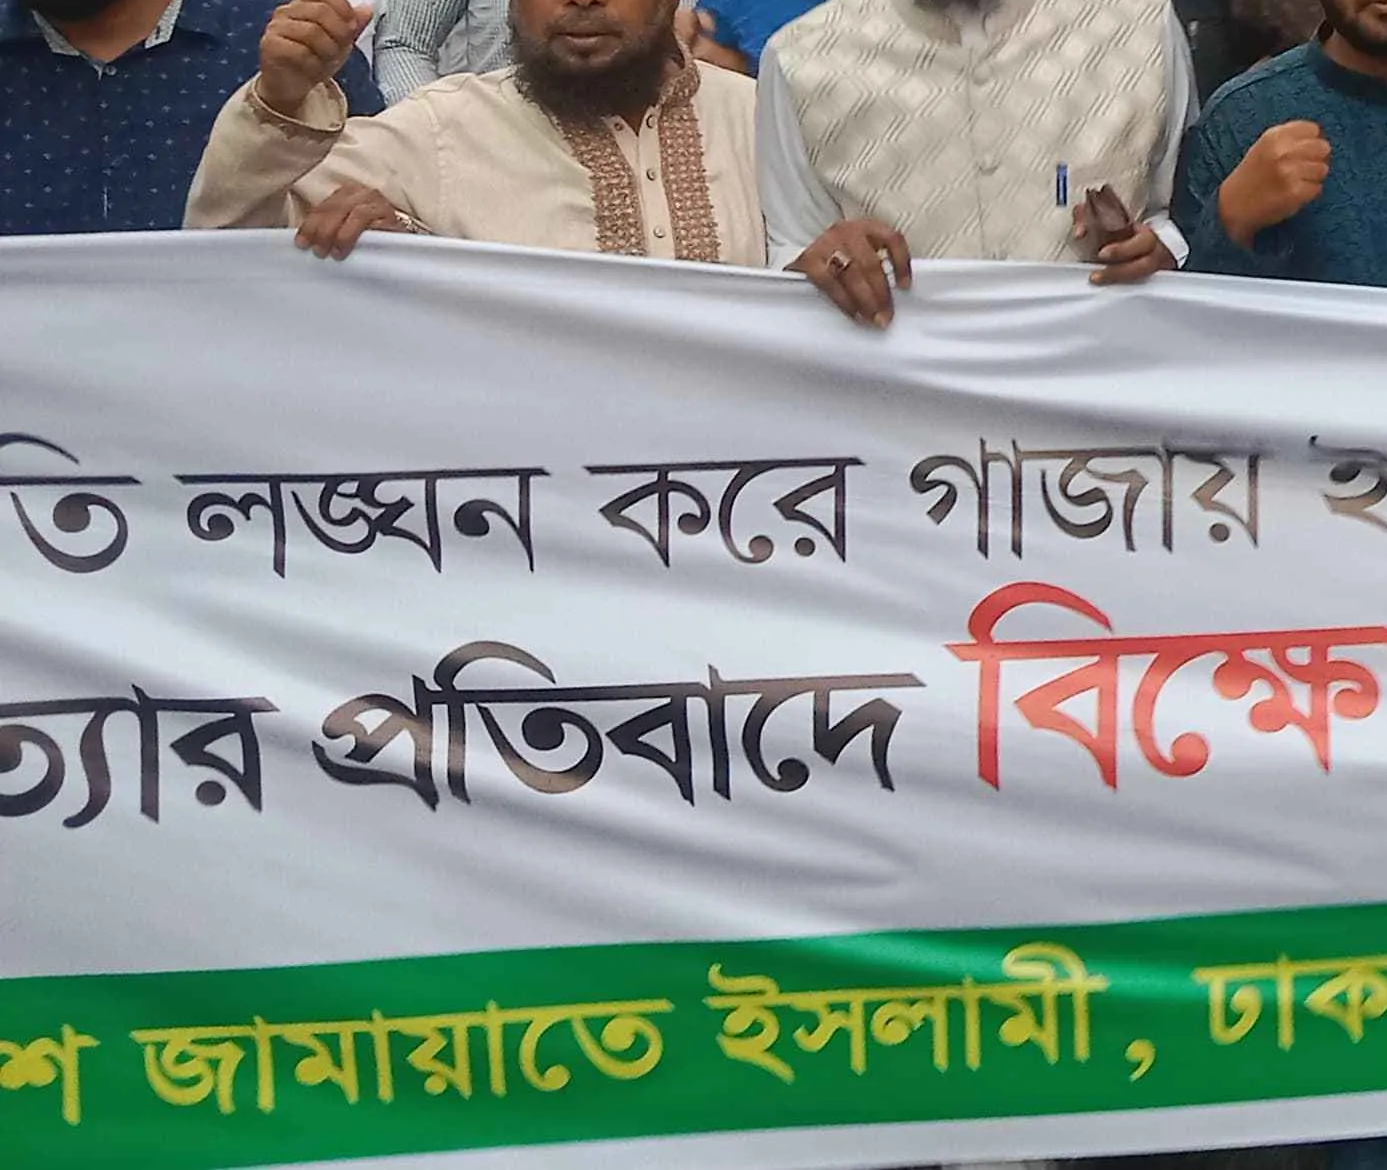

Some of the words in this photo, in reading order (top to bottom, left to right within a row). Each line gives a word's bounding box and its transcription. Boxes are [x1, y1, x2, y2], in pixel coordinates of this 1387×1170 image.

[173, 467, 551, 580] লঙ্ঘন
[583, 457, 866, 570] করে
[909, 436, 1273, 560] গাজায়
[312, 641, 926, 811] প্রতিবাদে
[131, 998, 673, 1114] জামায়াতে
